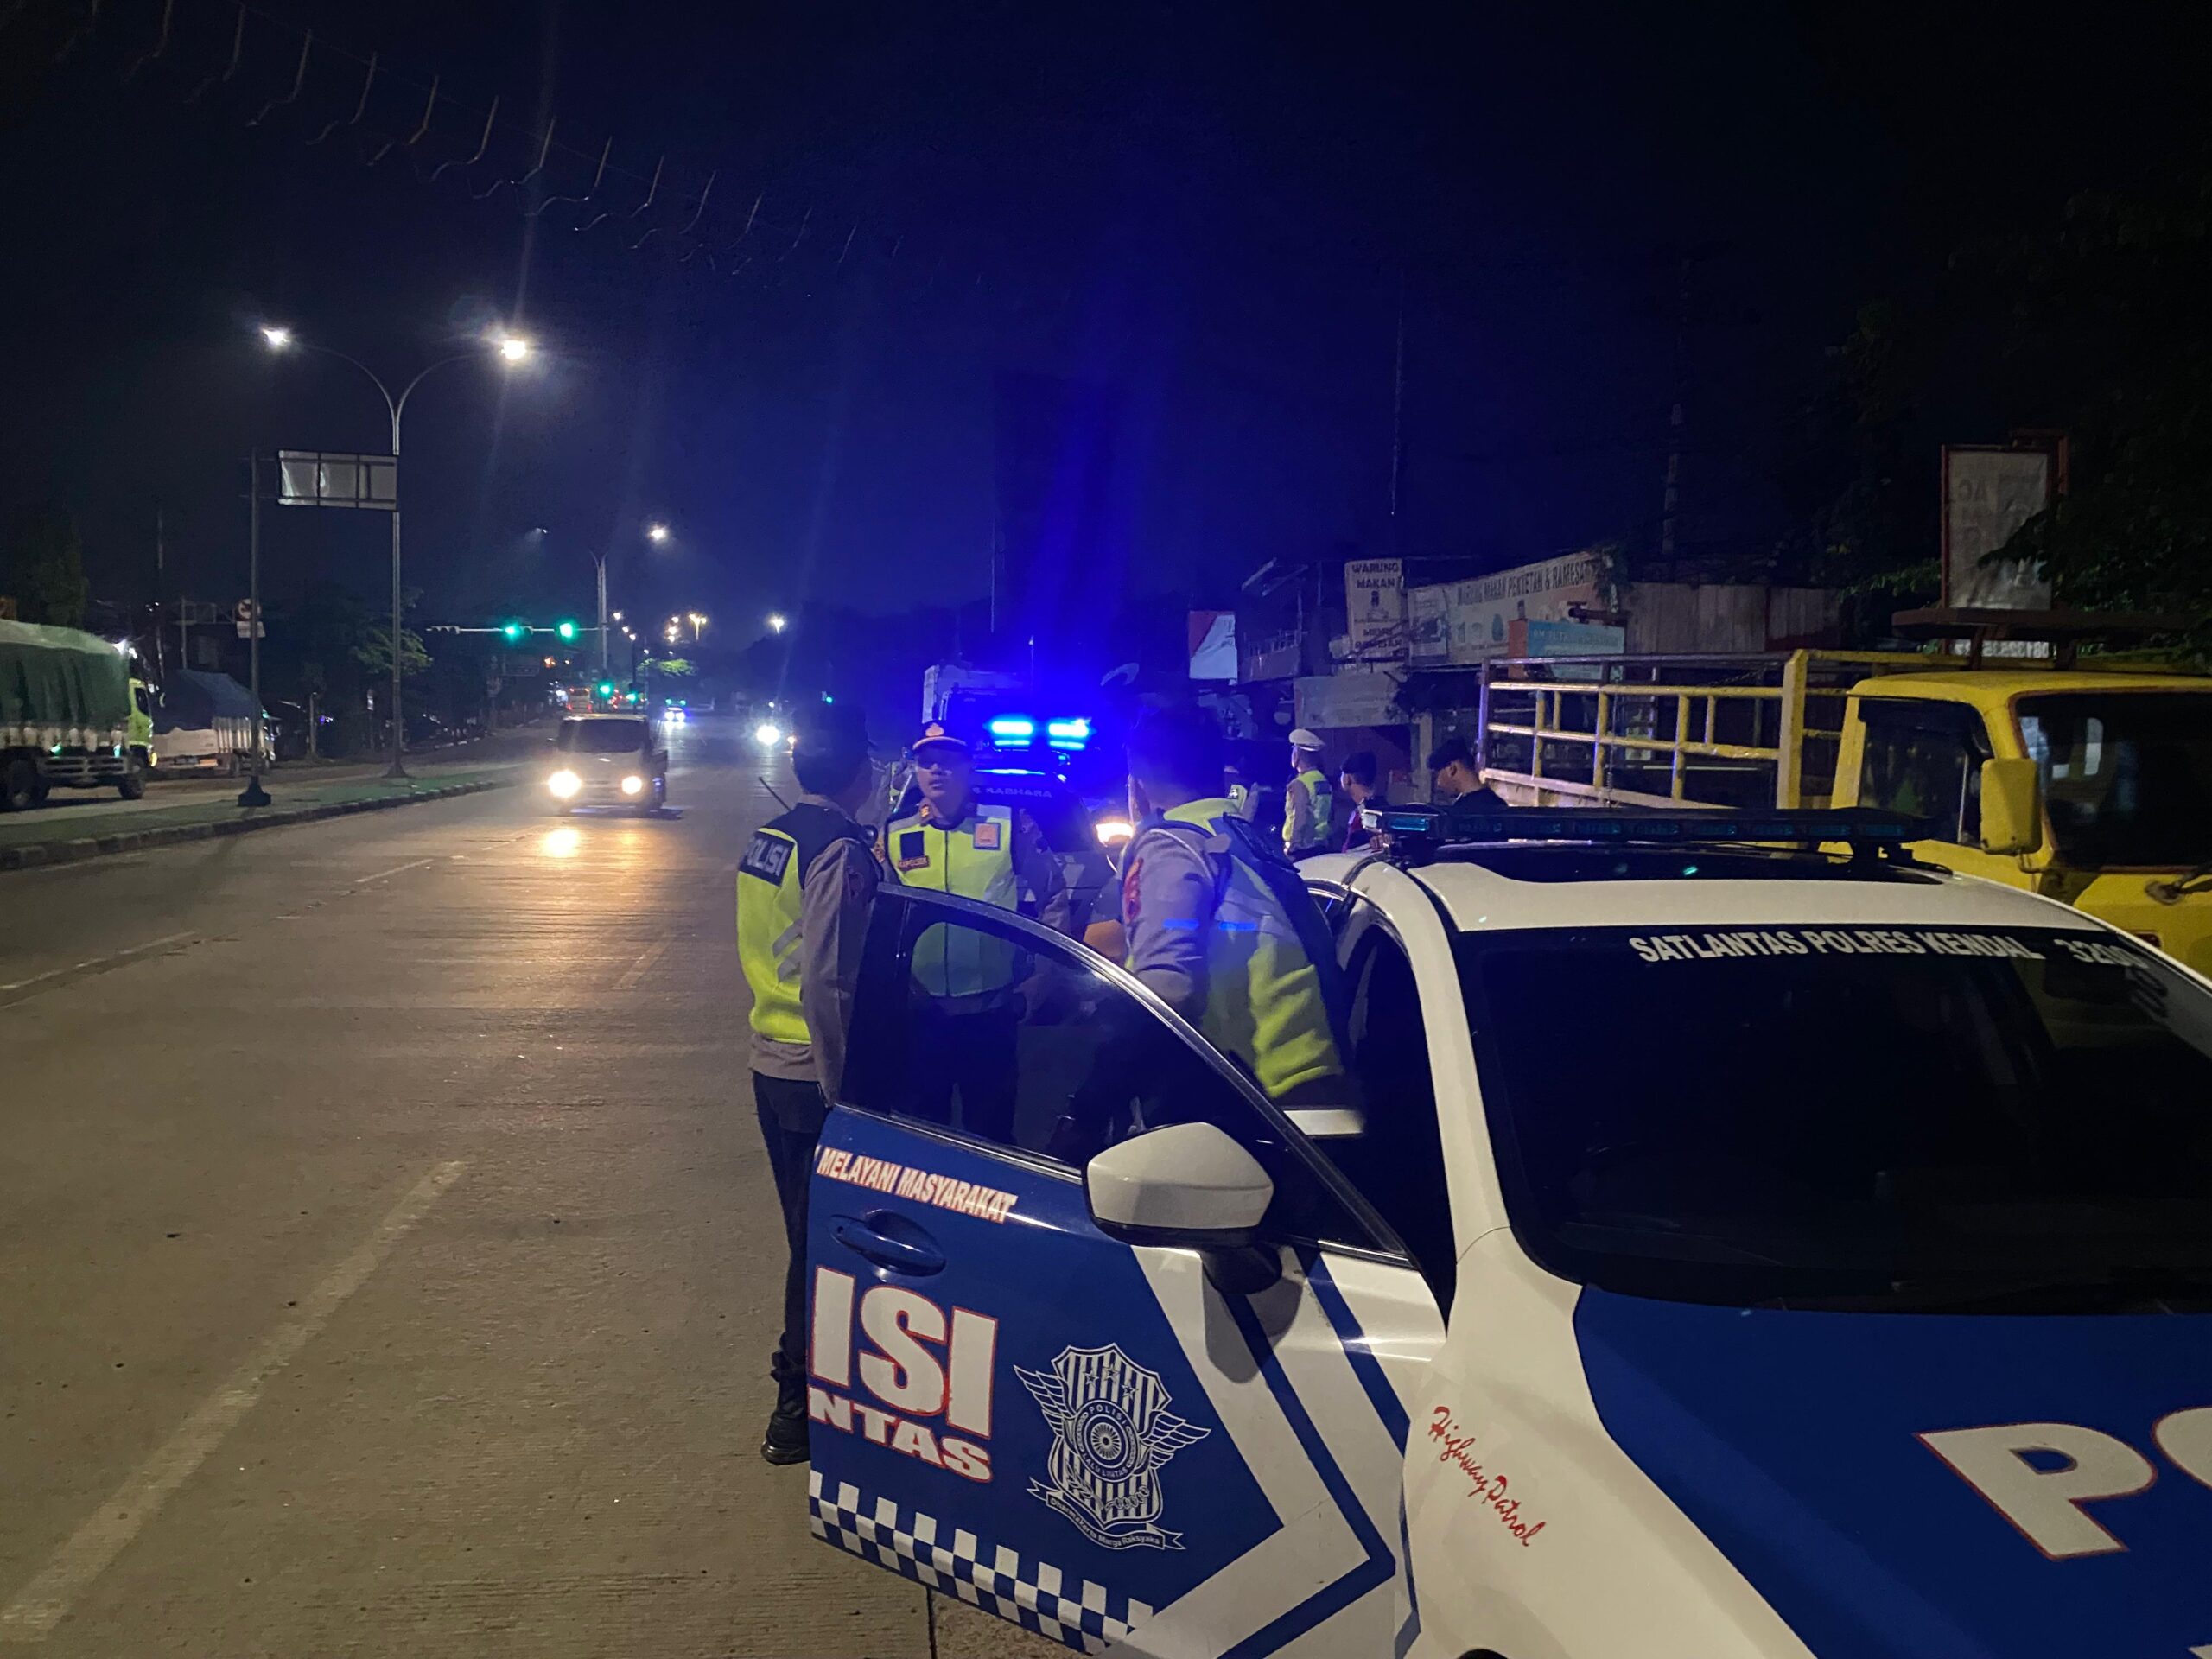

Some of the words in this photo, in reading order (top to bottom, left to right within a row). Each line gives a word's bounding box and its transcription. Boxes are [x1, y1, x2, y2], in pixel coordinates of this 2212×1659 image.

[1352, 563, 1399, 573] WARUNG
[1357, 578, 1395, 588] MAKAN
[1629, 930, 1810, 963] SATLANTAS
[1811, 931, 1927, 955] POLRES
[1914, 931, 2046, 960] KENDAL
[816, 1147, 903, 1193] MELAYANI
[895, 1166, 1019, 1224] MASYARAKAT
[809, 1264, 999, 1440] ISI
[1089, 1403, 1127, 1425] POLISI
[807, 1383, 994, 1484] NTAS
[1082, 1452, 1101, 1472] LALU
[1428, 1405, 1476, 1497] Highway
[1481, 1474, 1547, 1548] Patrol
